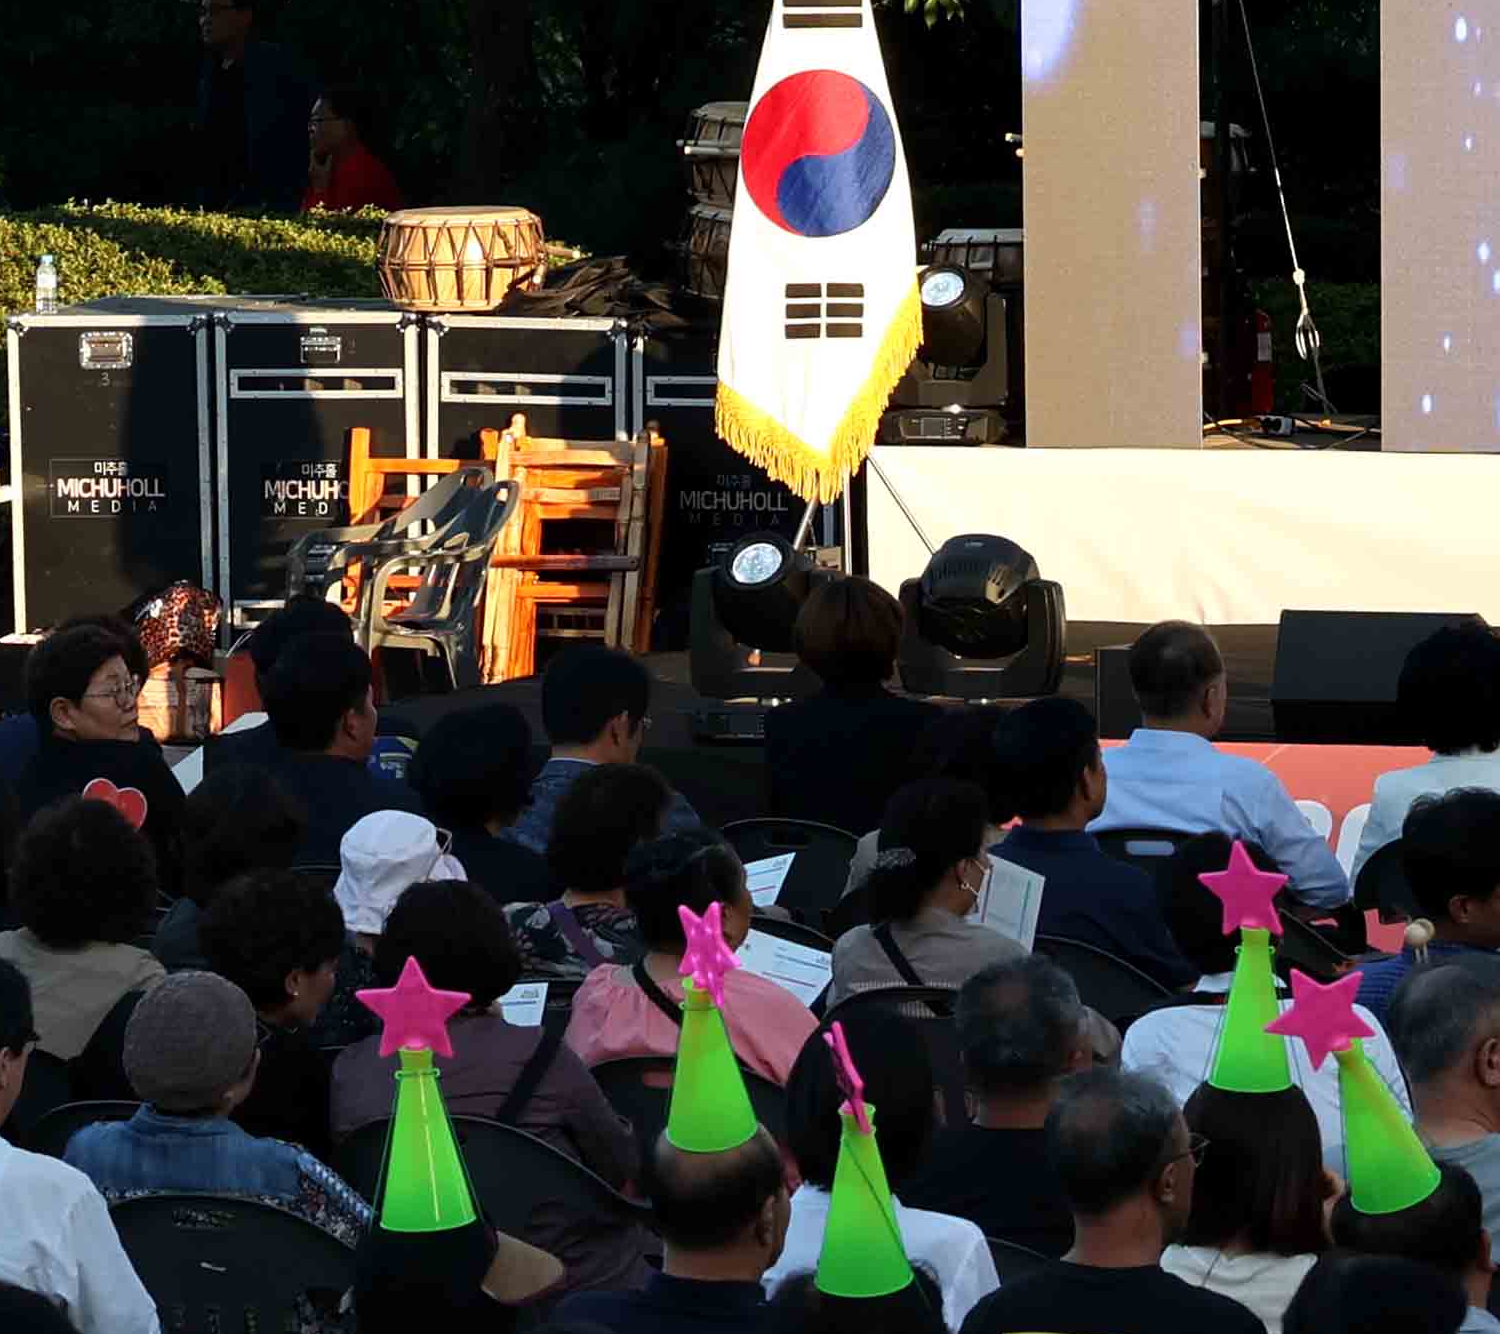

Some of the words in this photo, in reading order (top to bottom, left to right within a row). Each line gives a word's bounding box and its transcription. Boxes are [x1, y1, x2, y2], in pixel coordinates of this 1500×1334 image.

[57, 478, 165, 498] MICHUHOLL
[68, 501, 157, 513] MEDIA
[679, 491, 788, 511] MICHUHOLL
